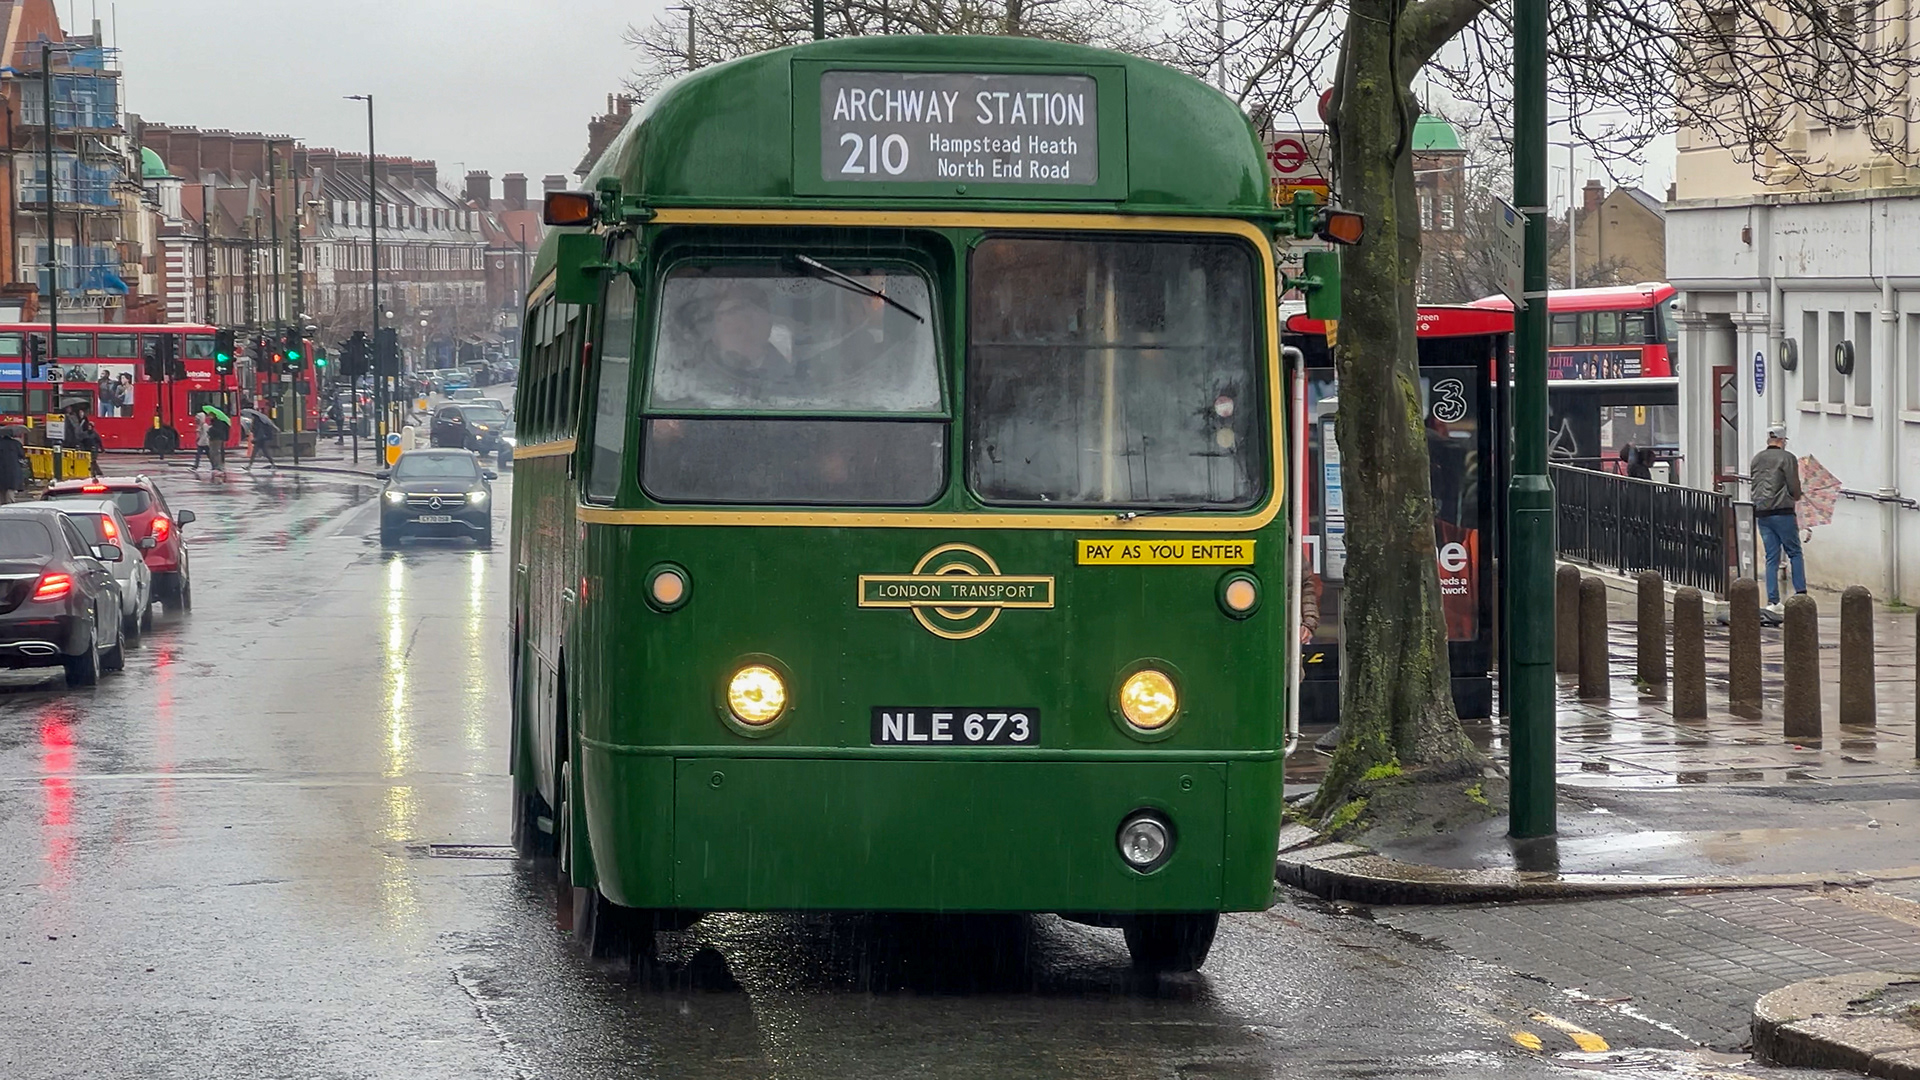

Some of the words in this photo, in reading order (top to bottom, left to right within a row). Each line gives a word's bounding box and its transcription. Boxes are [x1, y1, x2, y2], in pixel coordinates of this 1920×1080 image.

[833, 88, 959, 123] ARCHWAY
[976, 91, 1085, 126] STATION
[840, 132, 909, 176] 210
[930, 133, 1021, 157] Hampstead
[1029, 136, 1078, 155] Heath
[938, 158, 985, 178] North
[992, 158, 1022, 178] End
[1030, 160, 1070, 180] Road
[1087, 545, 1114, 559] PAY
[1121, 545, 1141, 559] AS
[1151, 545, 1185, 559] YOU
[1191, 545, 1244, 559] ENTER
[879, 584, 941, 597] LONDON
[951, 585, 1036, 598] TRANSPORT
[1440, 576, 1460, 586] eeds
[1461, 578, 1468, 586] a
[1441, 586, 1468, 595] twork
[881, 713, 954, 742] NLE
[962, 712, 1031, 742] 673
